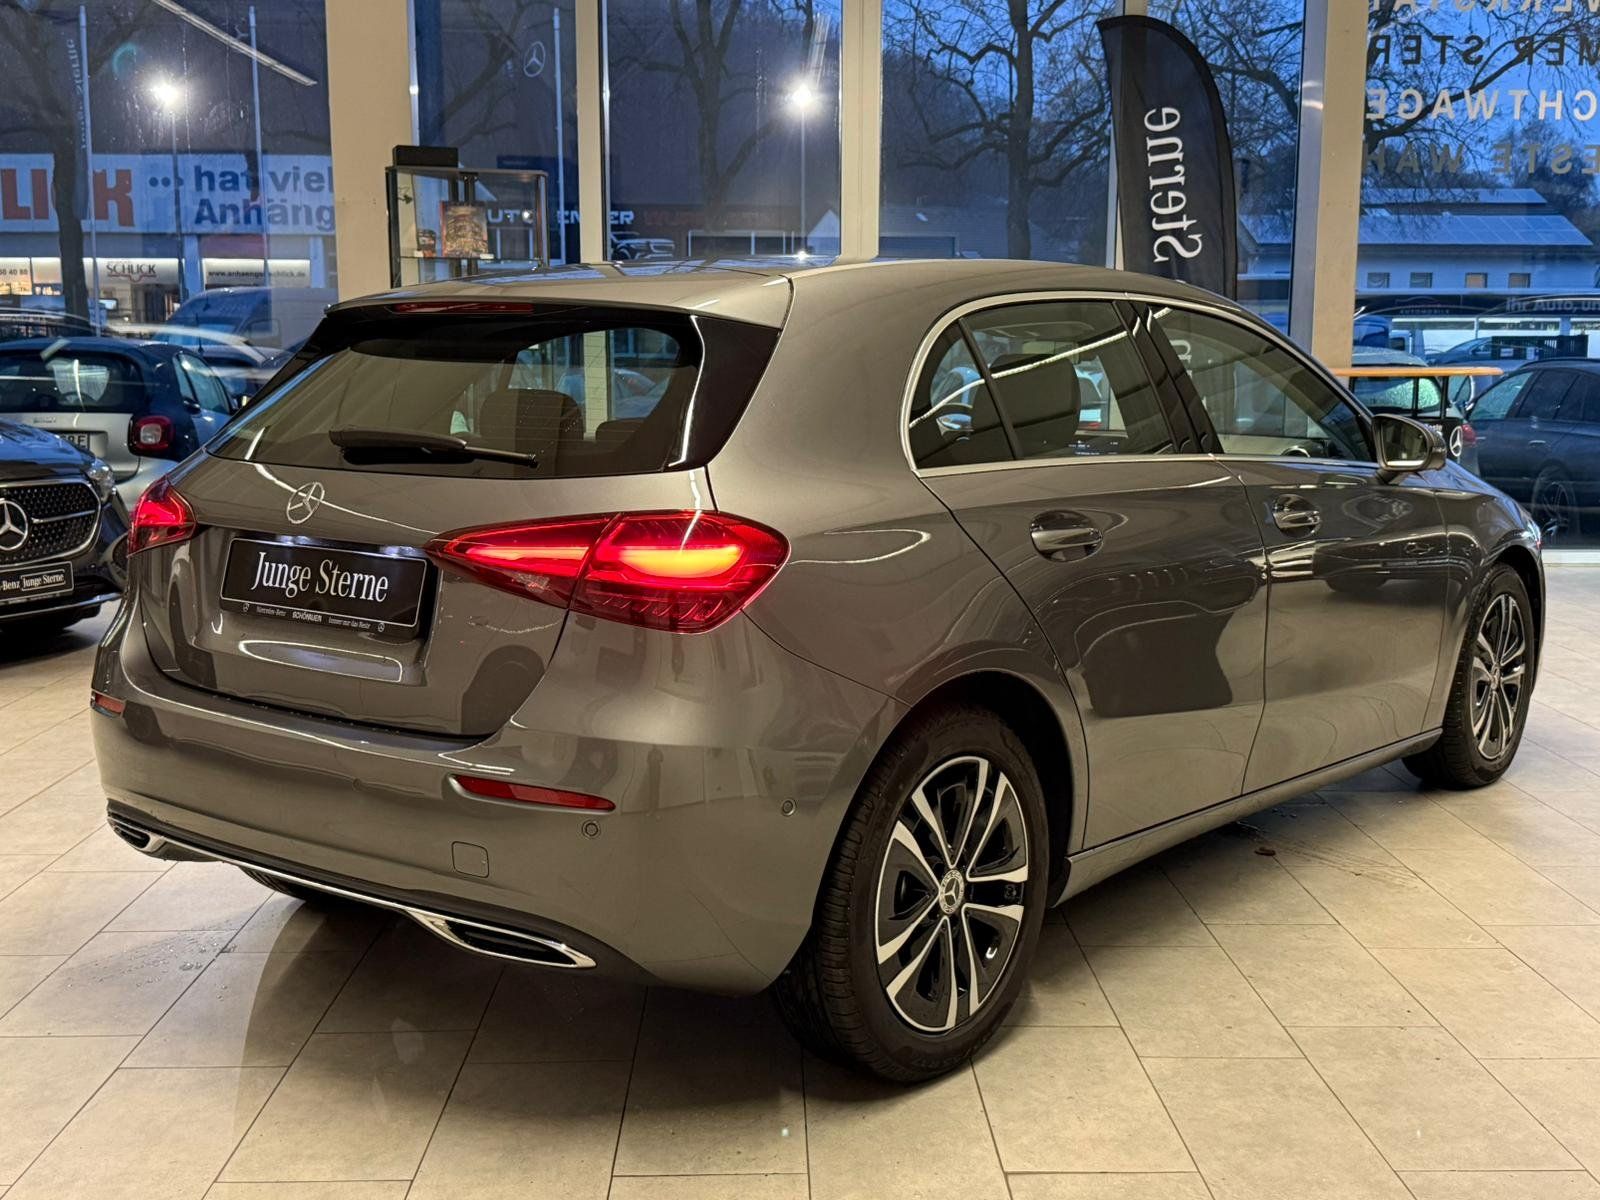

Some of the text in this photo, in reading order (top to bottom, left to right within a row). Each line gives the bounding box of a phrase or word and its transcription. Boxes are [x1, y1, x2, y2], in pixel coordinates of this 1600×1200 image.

[22, 576, 41, 588] Junge
[42, 573, 65, 584] Sterne
[251, 552, 389, 602] Junge Sterne
